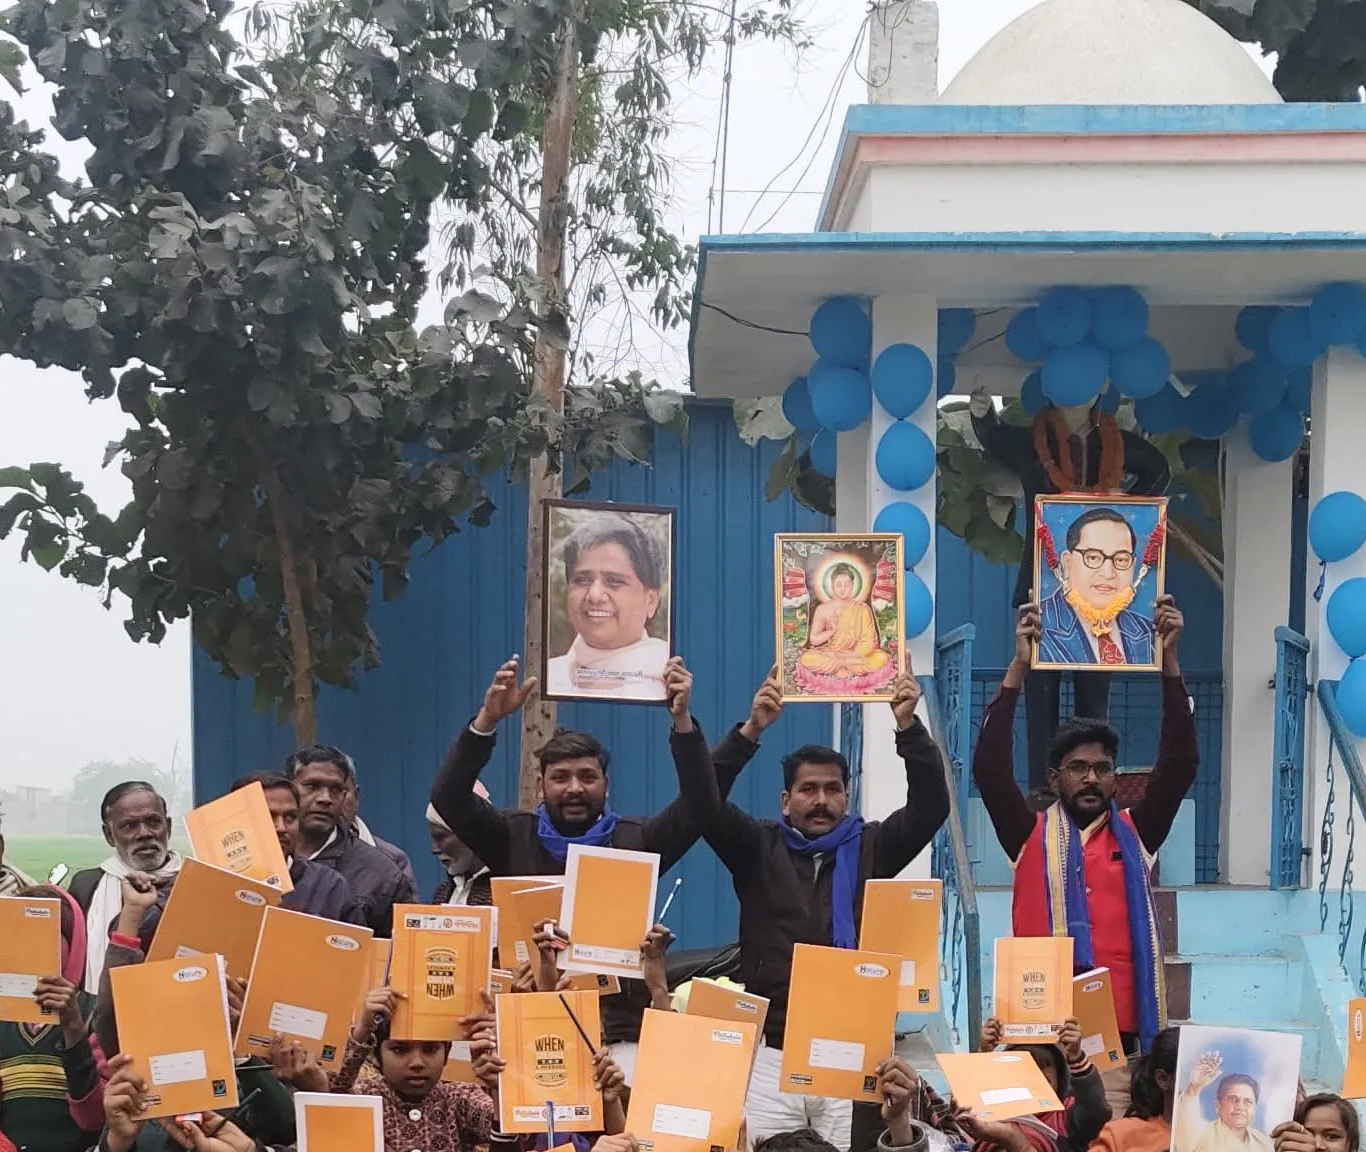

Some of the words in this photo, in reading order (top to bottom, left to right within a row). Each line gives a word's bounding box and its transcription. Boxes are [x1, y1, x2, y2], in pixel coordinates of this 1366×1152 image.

[1022, 972, 1046, 983] WHEN
[427, 983, 454, 996] WHEN
[535, 1037, 565, 1051] WHEN
